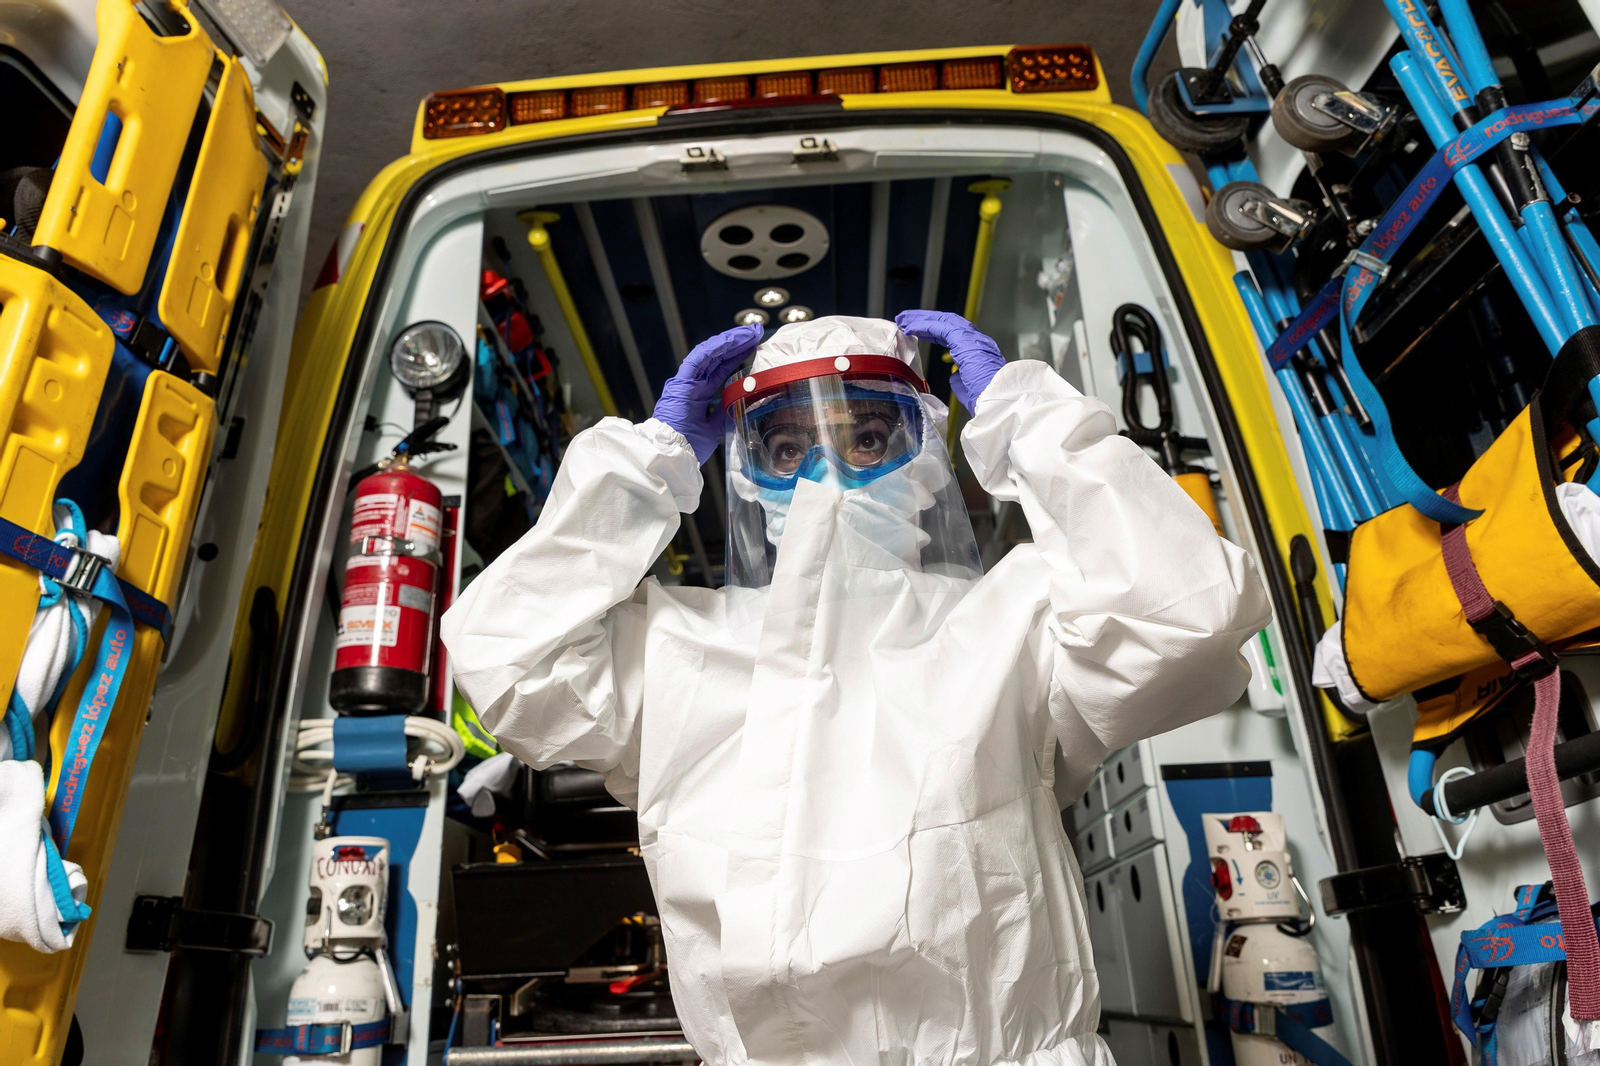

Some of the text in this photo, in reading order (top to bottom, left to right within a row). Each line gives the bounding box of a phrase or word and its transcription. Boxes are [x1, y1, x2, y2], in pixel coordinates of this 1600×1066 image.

[1372, 210, 1412, 251] lópez
[1408, 176, 1437, 212] auto
[60, 628, 127, 814] rodríguez lópez auto
